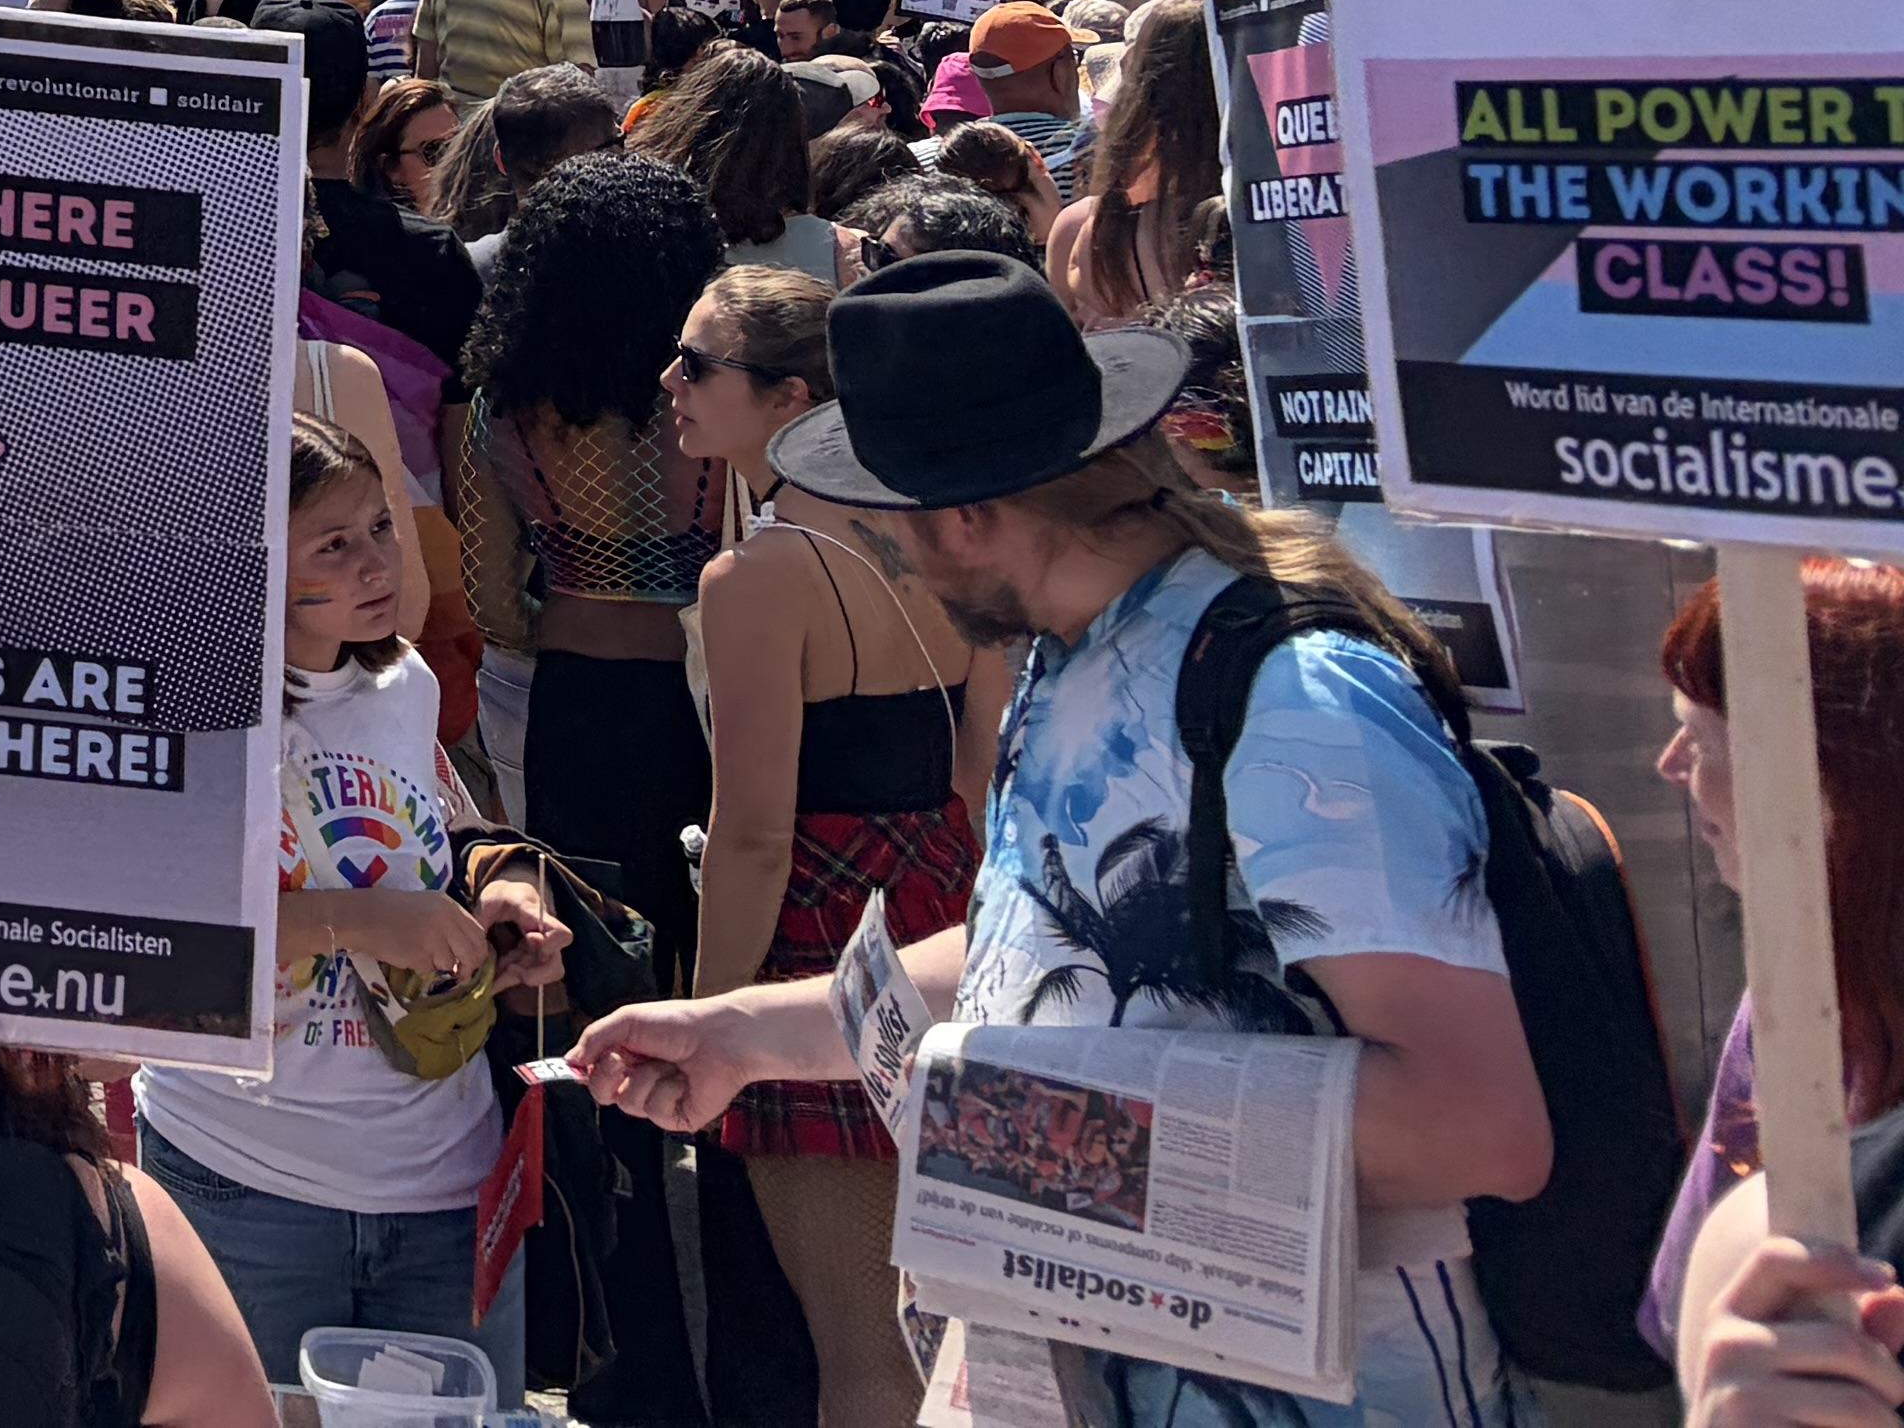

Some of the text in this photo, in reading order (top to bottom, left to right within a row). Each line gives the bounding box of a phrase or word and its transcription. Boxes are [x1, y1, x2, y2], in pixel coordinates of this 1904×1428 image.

[177, 92, 264, 115] solidair
[1461, 87, 1578, 144] ALL
[1596, 87, 1857, 144] POWER
[1467, 163, 1590, 222] THE
[1594, 245, 1849, 307] CLASS!
[1279, 391, 1321, 424] NOT
[1505, 381, 1899, 432] Word lid van de Internationale
[22, 657, 147, 715] ARE
[49, 918, 172, 957] Socialisten
[1001, 1246, 1146, 1308] socialist
[1169, 1295, 1213, 1331] de
